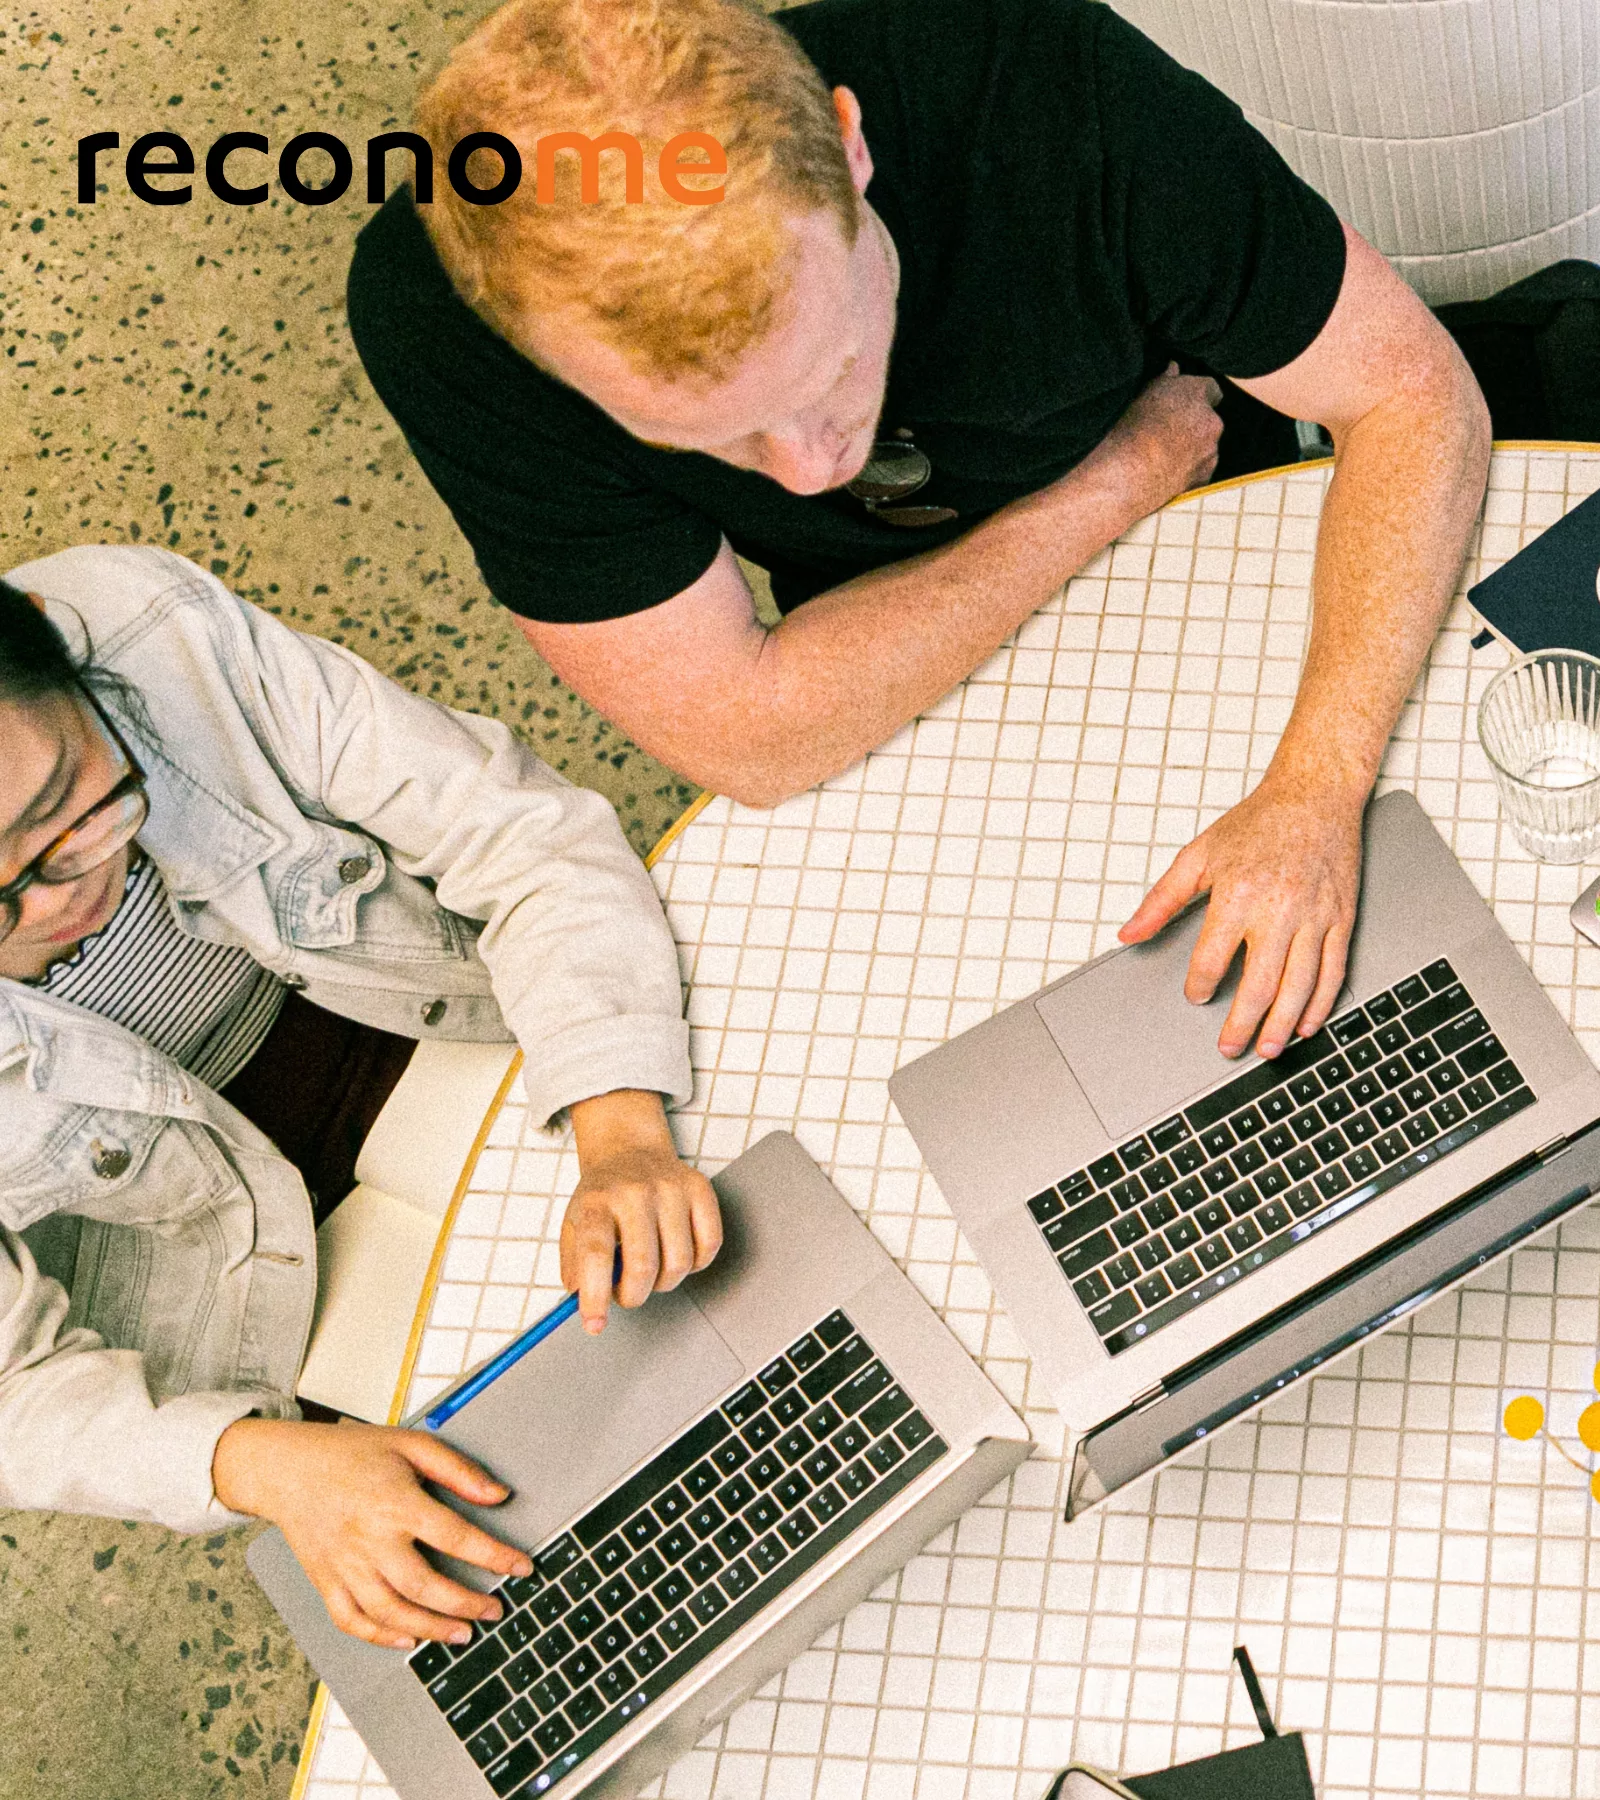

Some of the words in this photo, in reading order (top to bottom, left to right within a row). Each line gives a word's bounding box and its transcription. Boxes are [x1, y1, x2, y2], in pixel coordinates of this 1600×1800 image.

[1333, 1012, 1359, 1030] command
[1152, 1117, 1179, 1136] command
[725, 1386, 751, 1410] command
[540, 1538, 567, 1562] command
